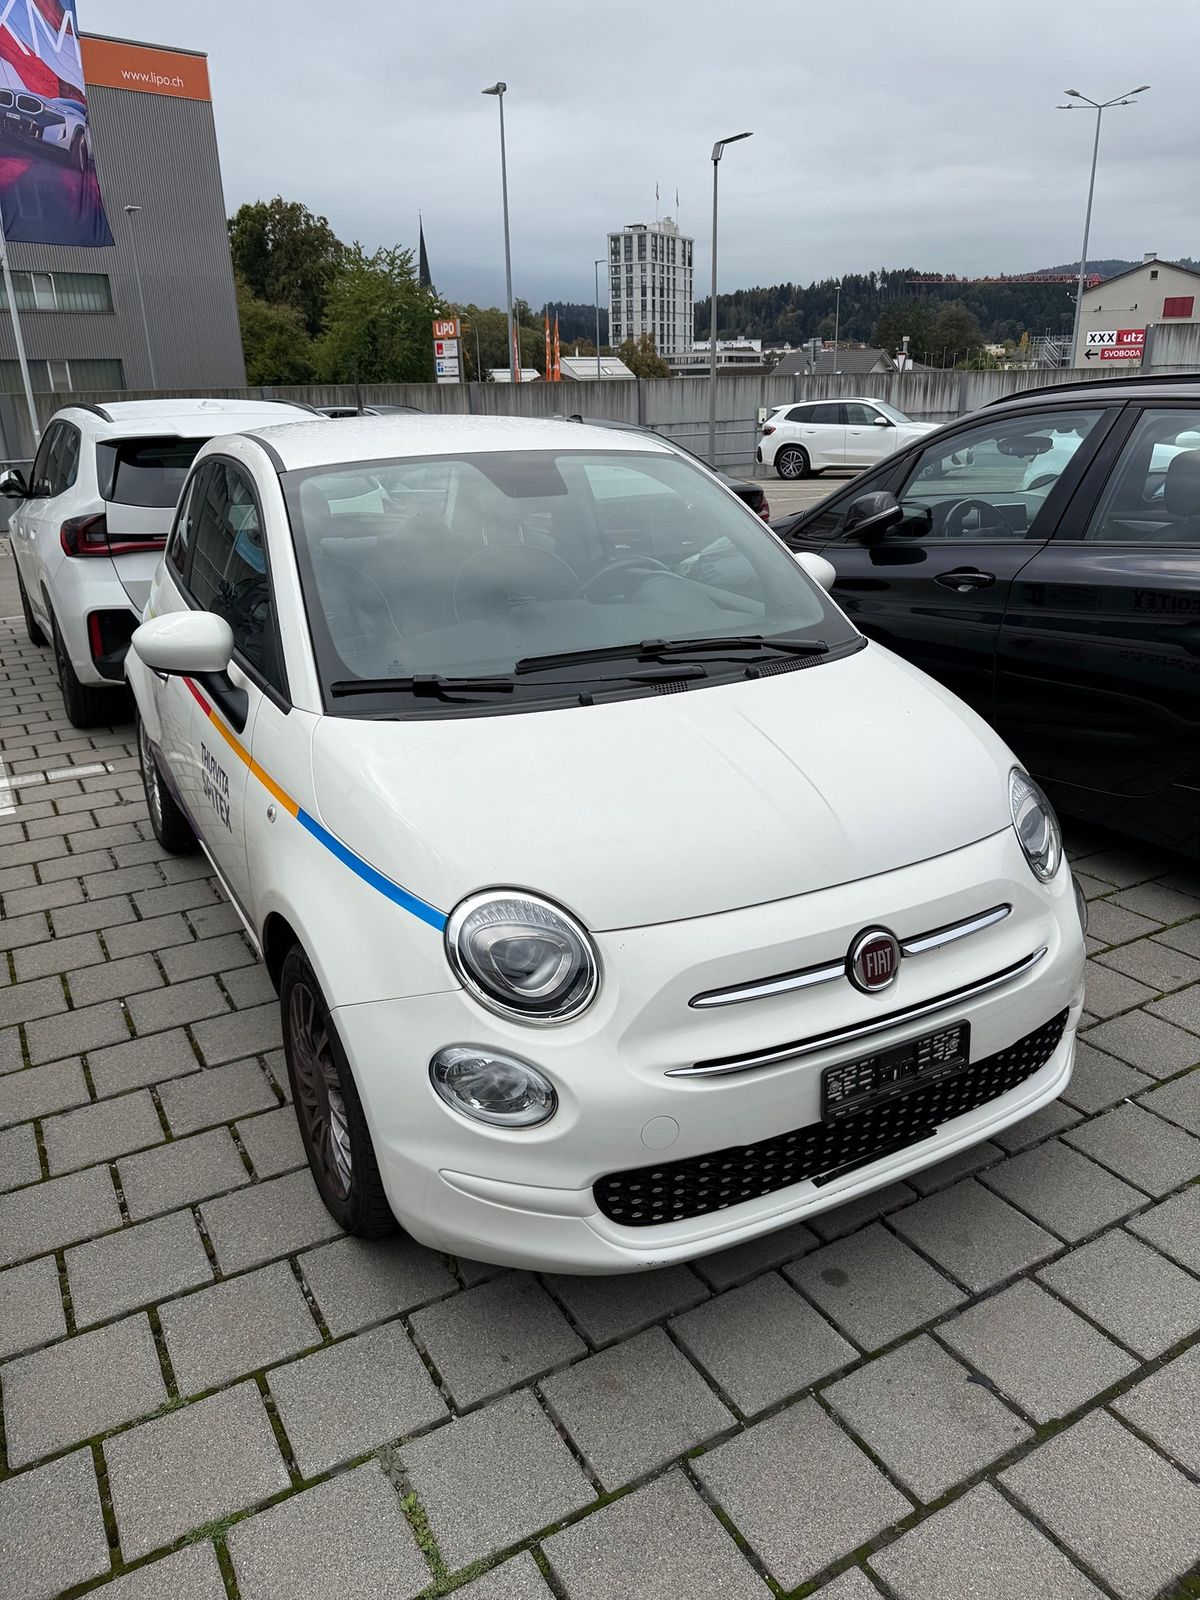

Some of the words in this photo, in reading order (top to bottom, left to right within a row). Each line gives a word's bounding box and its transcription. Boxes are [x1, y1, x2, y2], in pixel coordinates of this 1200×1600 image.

[121, 68, 185, 88] www.lipo.ch
[1103, 349, 1141, 358] SVOBODA
[200, 741, 230, 799] THURVITA
[201, 768, 233, 834] SPITEX
[865, 946, 892, 979] FIAT
